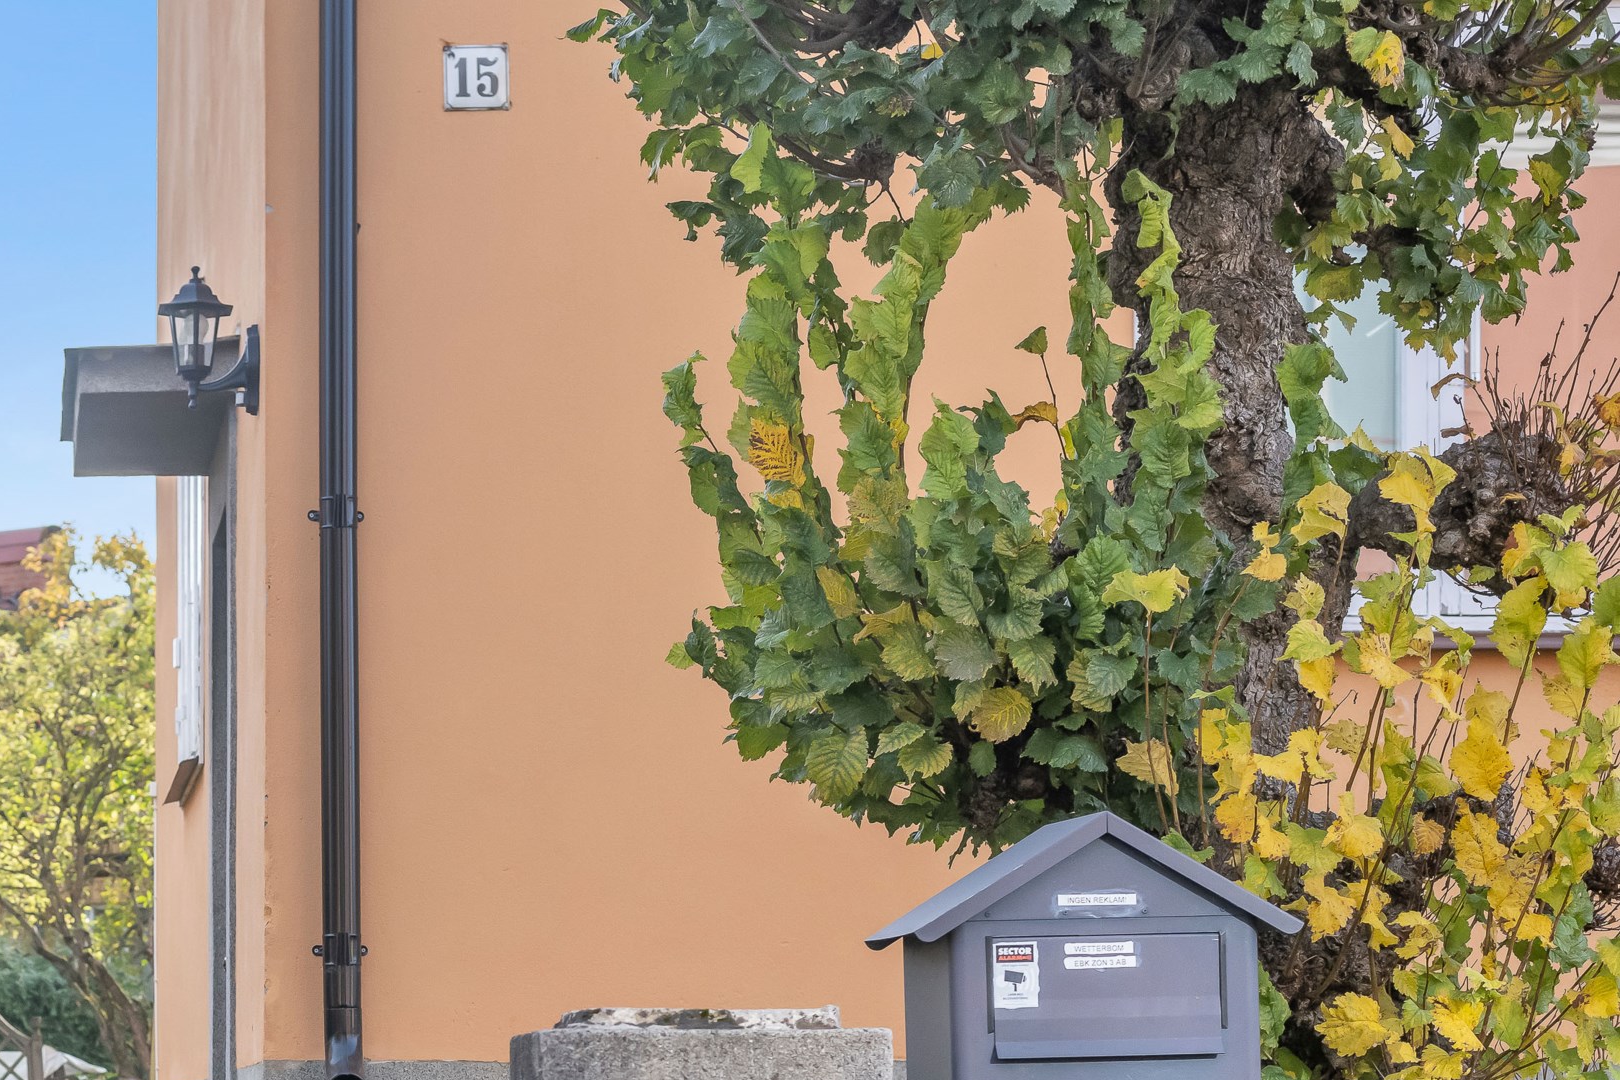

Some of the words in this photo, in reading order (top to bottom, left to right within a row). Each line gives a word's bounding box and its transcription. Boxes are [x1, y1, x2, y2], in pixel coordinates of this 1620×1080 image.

[454, 57, 499, 97] 15
[1067, 896, 1091, 904] INGEN
[998, 947, 1033, 955] SECTOR
[1092, 959, 1108, 967] ZON
[1116, 958, 1127, 966] AB
